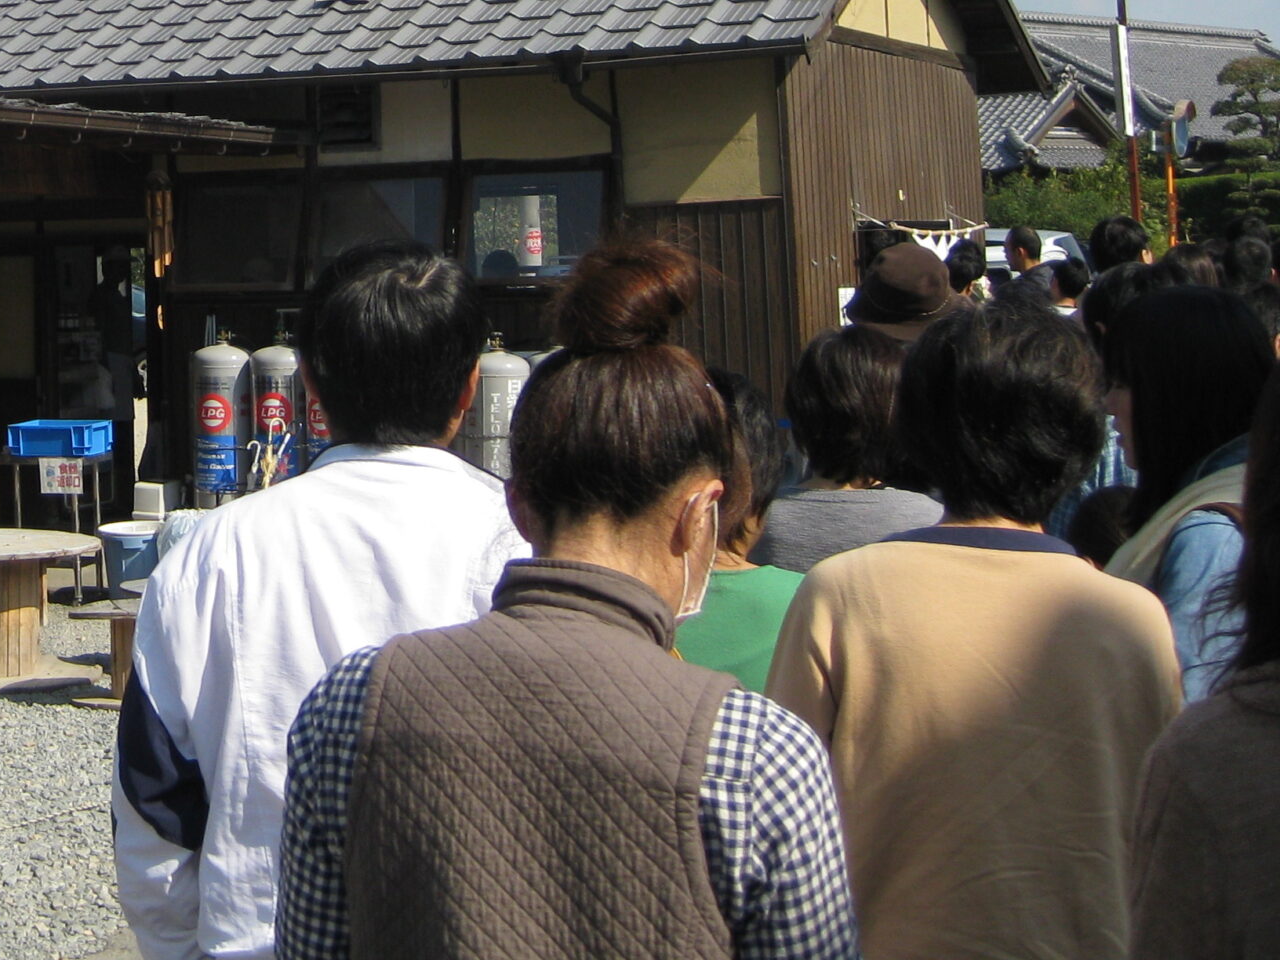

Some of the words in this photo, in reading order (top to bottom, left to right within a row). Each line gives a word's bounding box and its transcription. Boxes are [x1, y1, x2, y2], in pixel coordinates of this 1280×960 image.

[201, 407, 226, 418] LPG
[261, 407, 286, 417] LPG
[56, 476, 80, 487] 返却口
